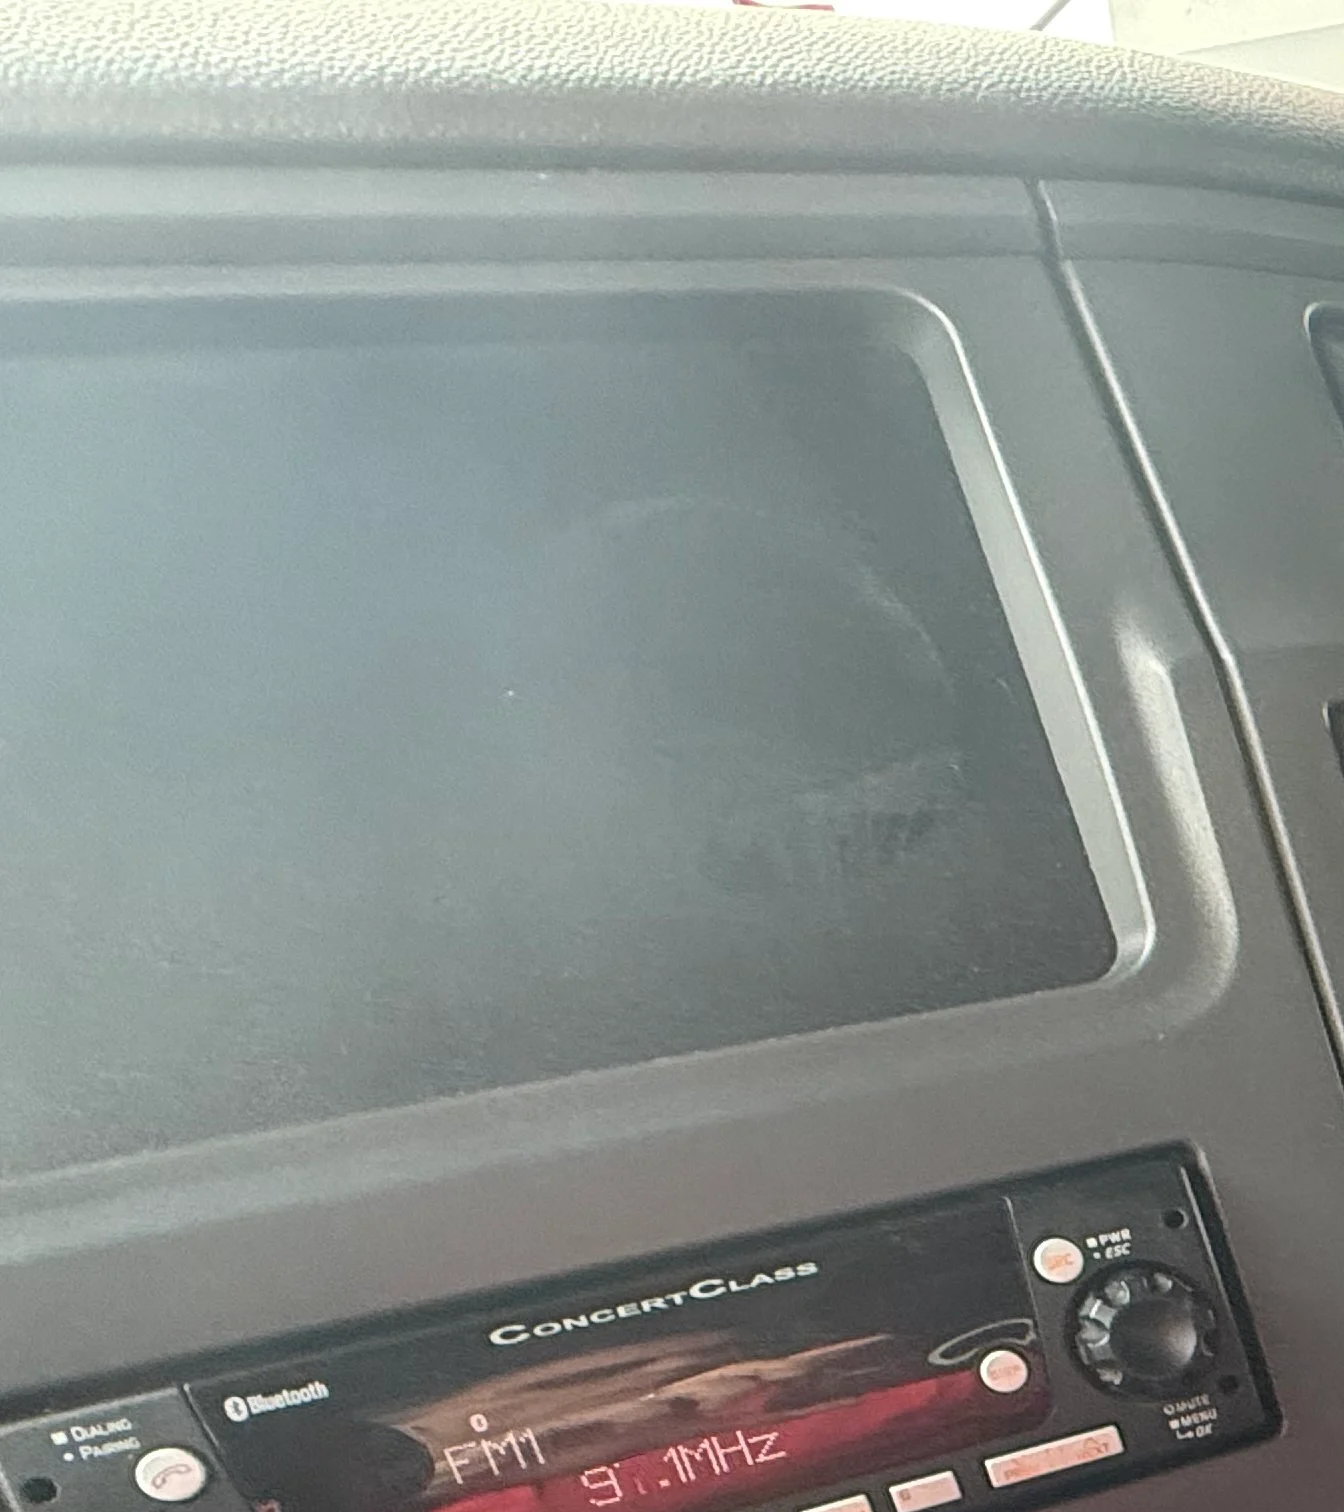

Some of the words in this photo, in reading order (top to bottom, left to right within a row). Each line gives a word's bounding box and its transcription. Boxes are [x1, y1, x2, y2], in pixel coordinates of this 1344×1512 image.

[1098, 1228, 1132, 1247] PWR
[1104, 1243, 1132, 1260] ESC
[247, 1381, 330, 1415] Bluetooth
[1179, 1409, 1218, 1427] MENU
[442, 1427, 546, 1485] FM1
